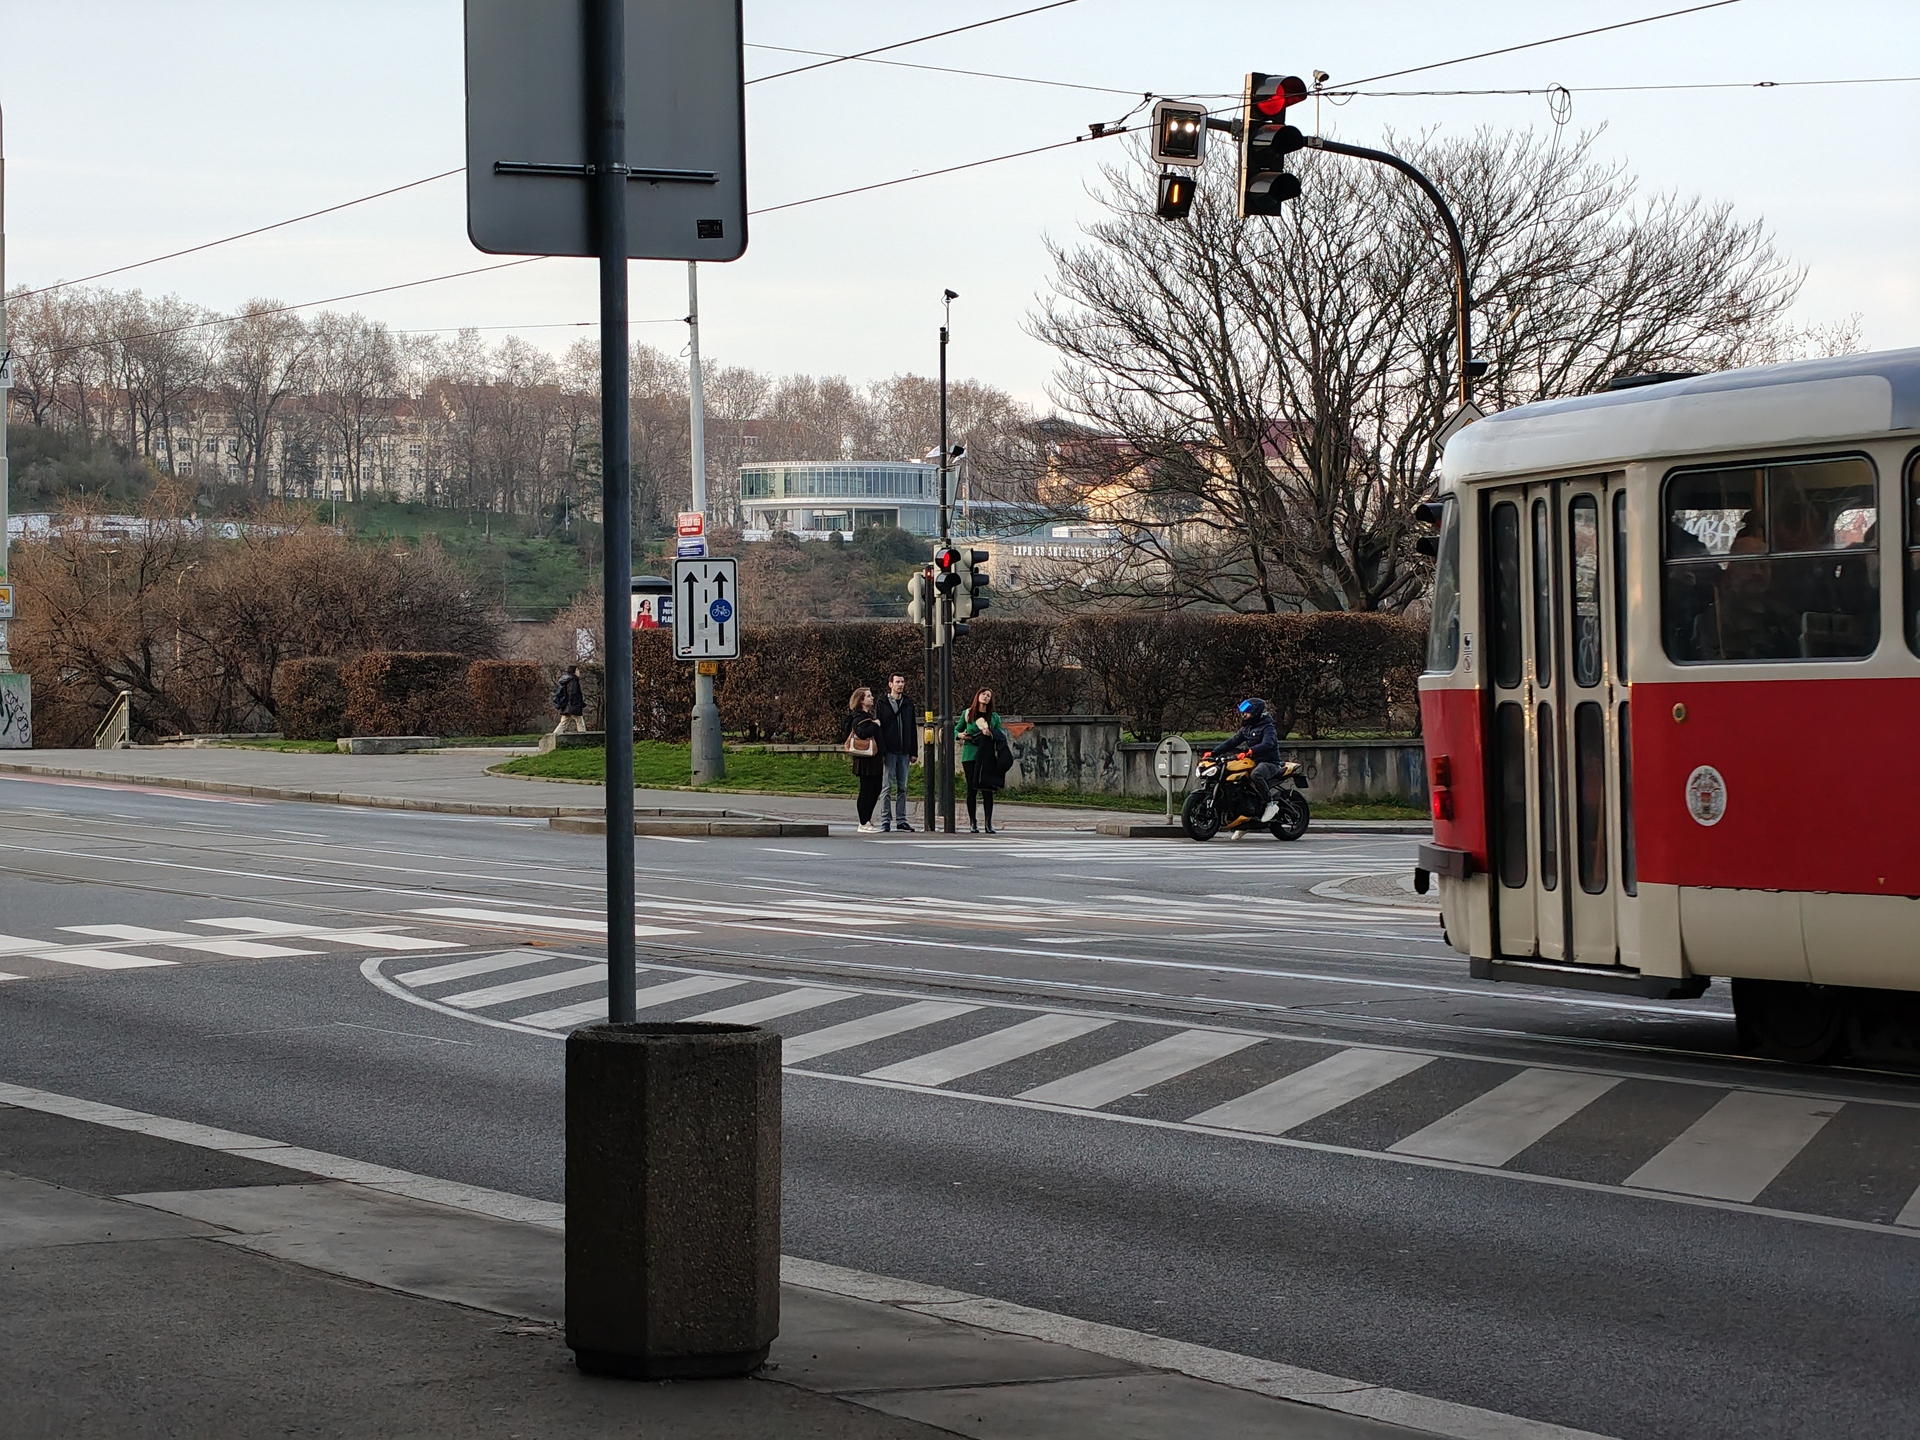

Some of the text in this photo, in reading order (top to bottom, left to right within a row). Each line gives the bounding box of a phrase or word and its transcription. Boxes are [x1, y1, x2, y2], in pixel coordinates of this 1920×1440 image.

[1013, 546, 1032, 556] EXPO
[1035, 546, 1045, 556] 58
[1048, 546, 1062, 557] ART
